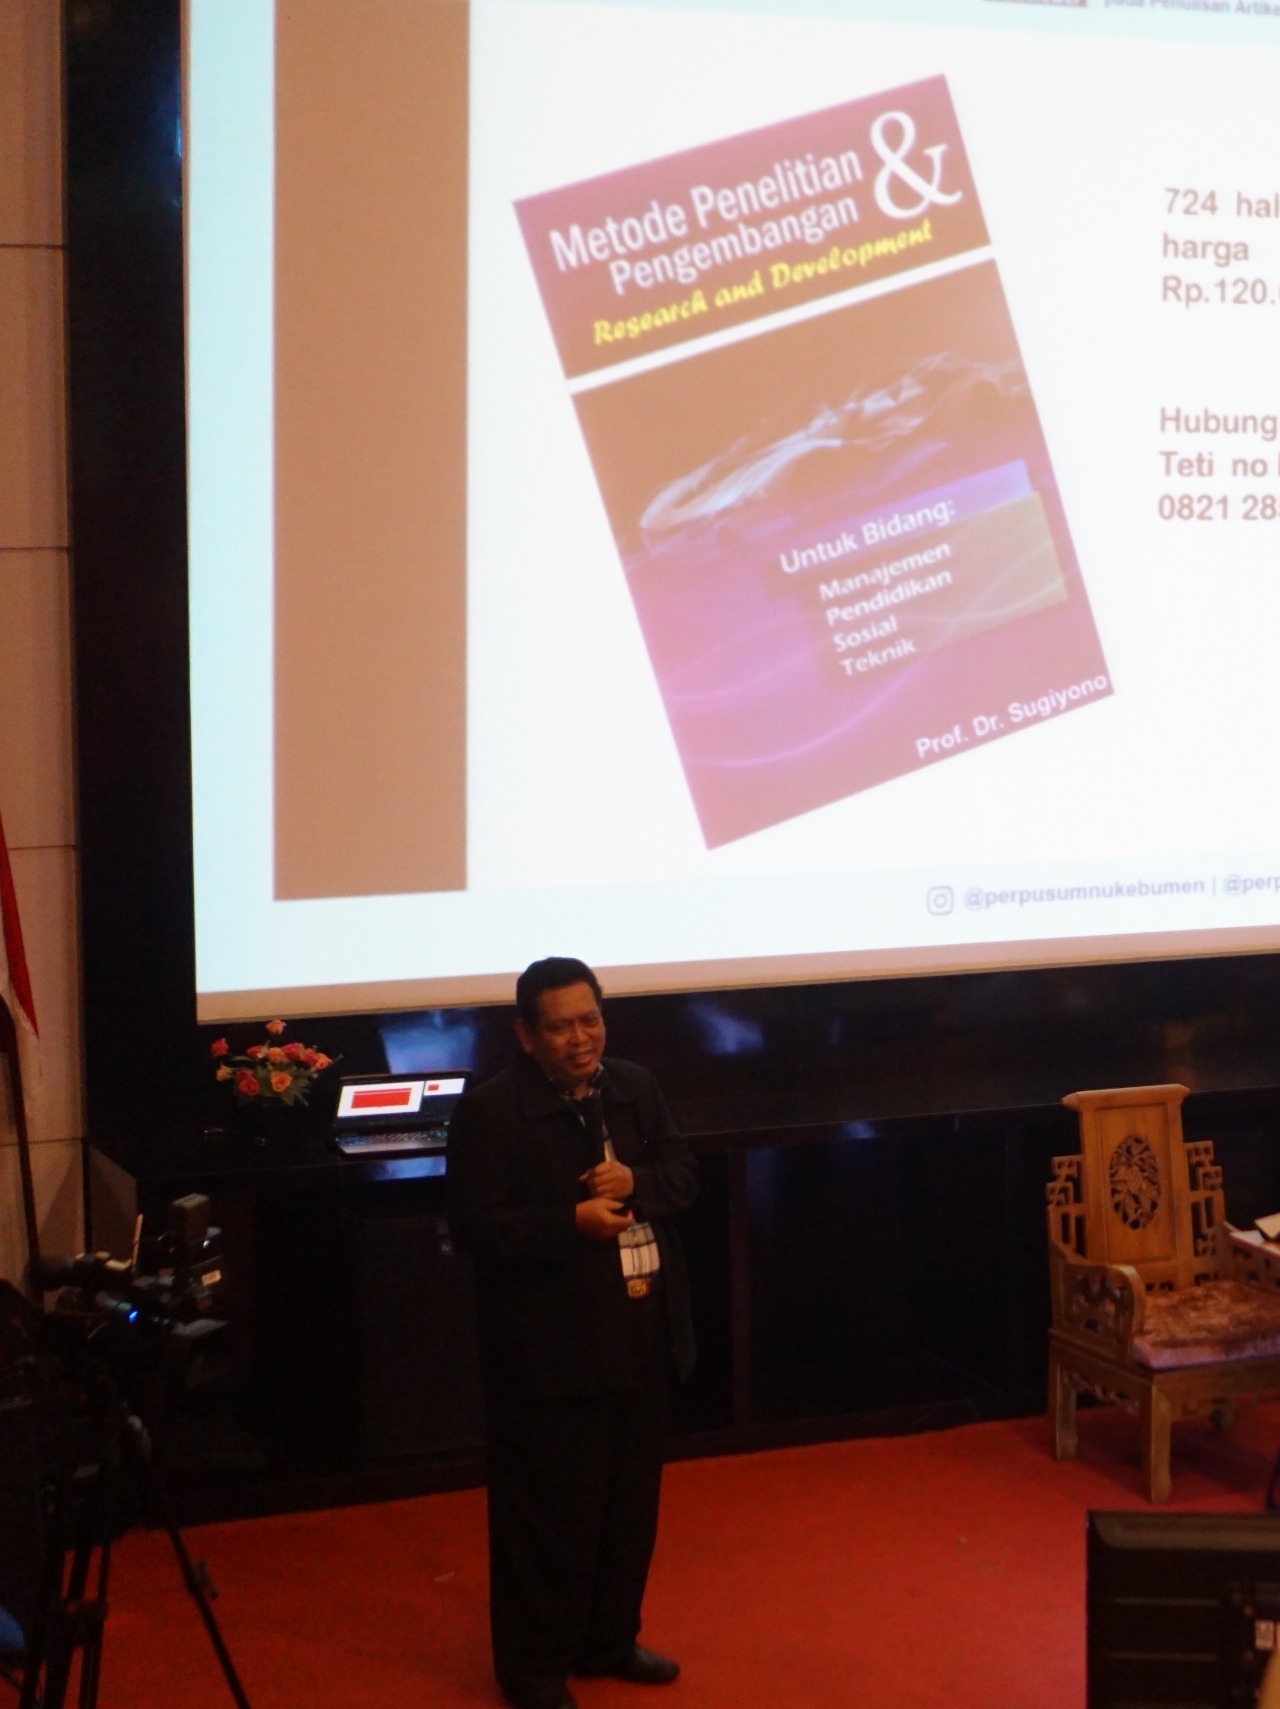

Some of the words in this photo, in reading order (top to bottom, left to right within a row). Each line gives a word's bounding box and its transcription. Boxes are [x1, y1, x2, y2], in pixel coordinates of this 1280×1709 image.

[870, 111, 963, 219] &
[550, 200, 689, 272] Metode
[691, 149, 863, 227] Penelitian
[1164, 187, 1218, 216] 724
[609, 196, 859, 296] Pengembangan
[1162, 232, 1250, 268] harga
[593, 290, 708, 345] Research
[714, 268, 764, 308] and
[770, 221, 932, 290] Development
[1158, 450, 1214, 477] Teti
[1232, 456, 1268, 478] no
[780, 534, 858, 574] Untuk
[861, 499, 956, 547] Bidang:
[1158, 494, 1229, 521] 0821
[819, 541, 952, 601] Manajemen
[826, 568, 952, 626] Pendidikan
[833, 615, 898, 653] Sosial
[839, 640, 917, 677] Teknik
[915, 725, 969, 759] Prof.
[973, 711, 1004, 738] Dr.
[1008, 673, 1108, 724] Sugiyono
[963, 879, 1205, 911] @perpusumnukebumen
